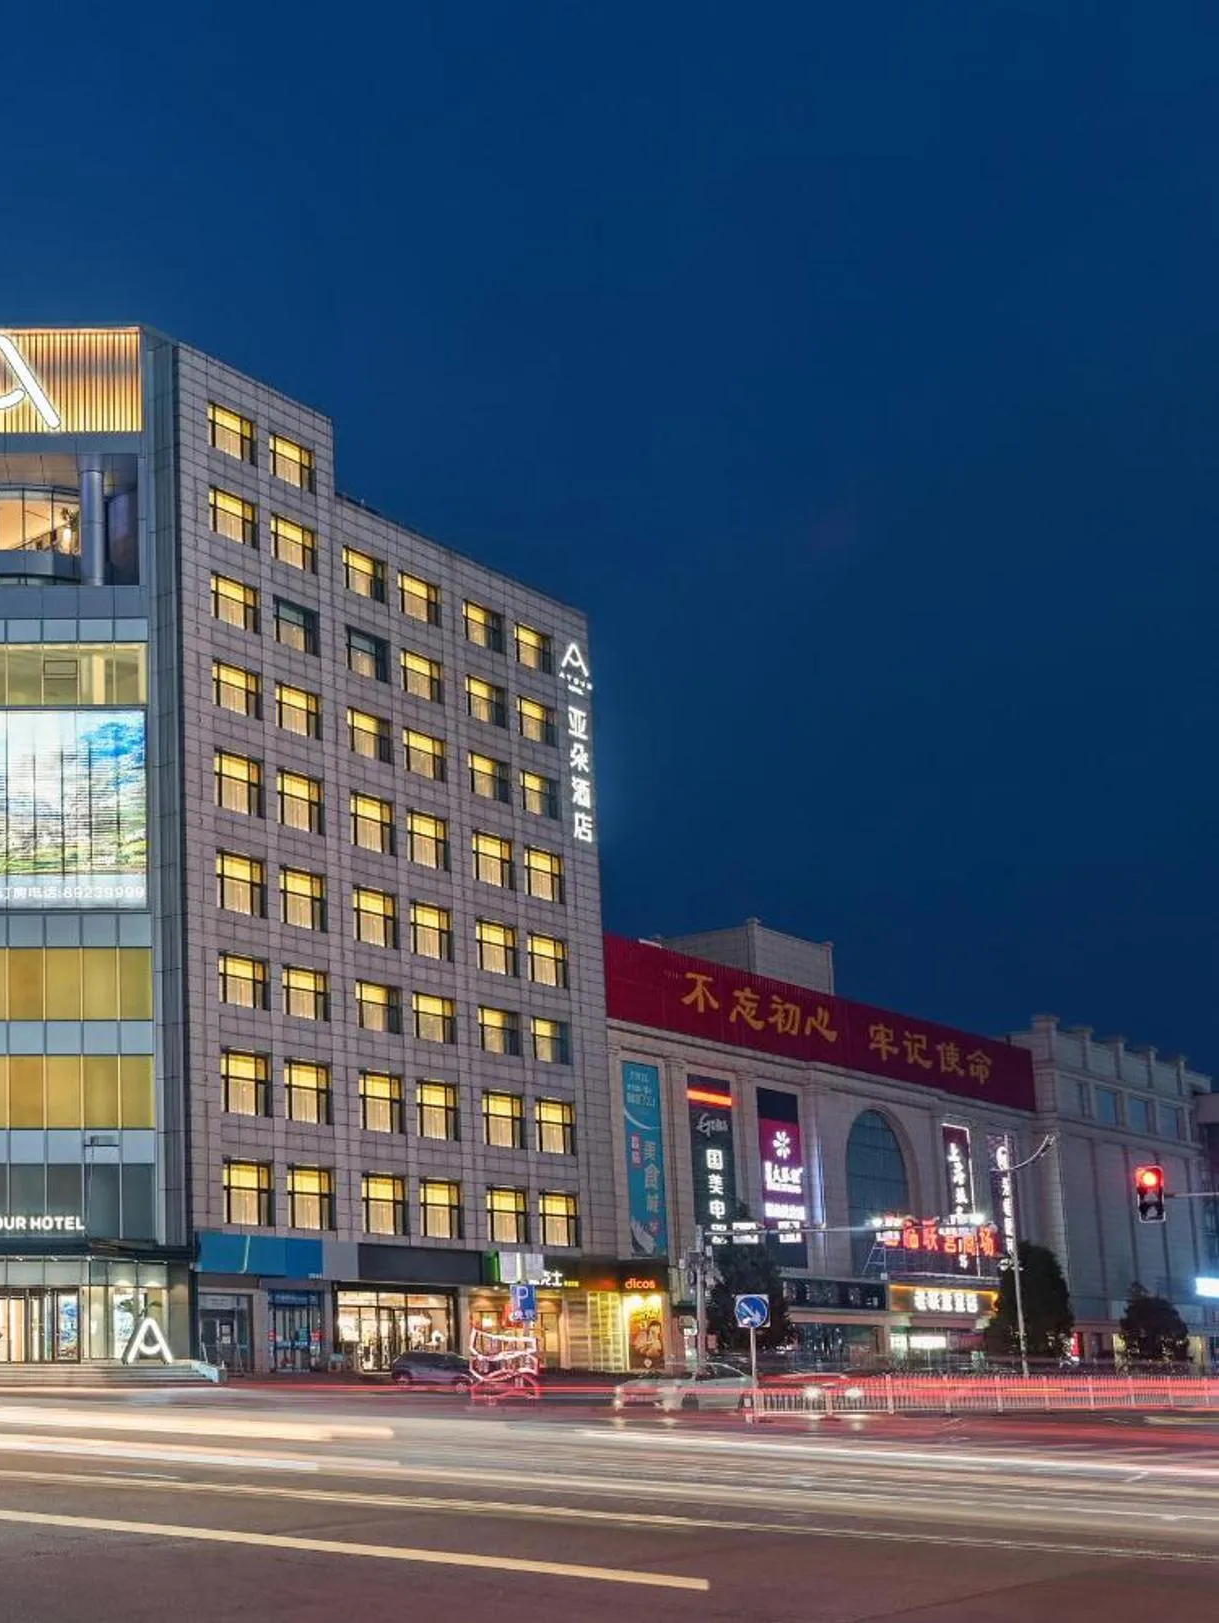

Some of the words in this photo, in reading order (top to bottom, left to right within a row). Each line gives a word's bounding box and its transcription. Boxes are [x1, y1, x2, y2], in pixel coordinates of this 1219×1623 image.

[568, 705, 593, 844] 亚朵酒店
[681, 971, 838, 1044] 不忘初心
[868, 1022, 993, 1086] 牢记使命
[29, 1215, 86, 1231] HOTEL
[625, 1277, 656, 1289] dicos
[516, 1286, 529, 1309] P
